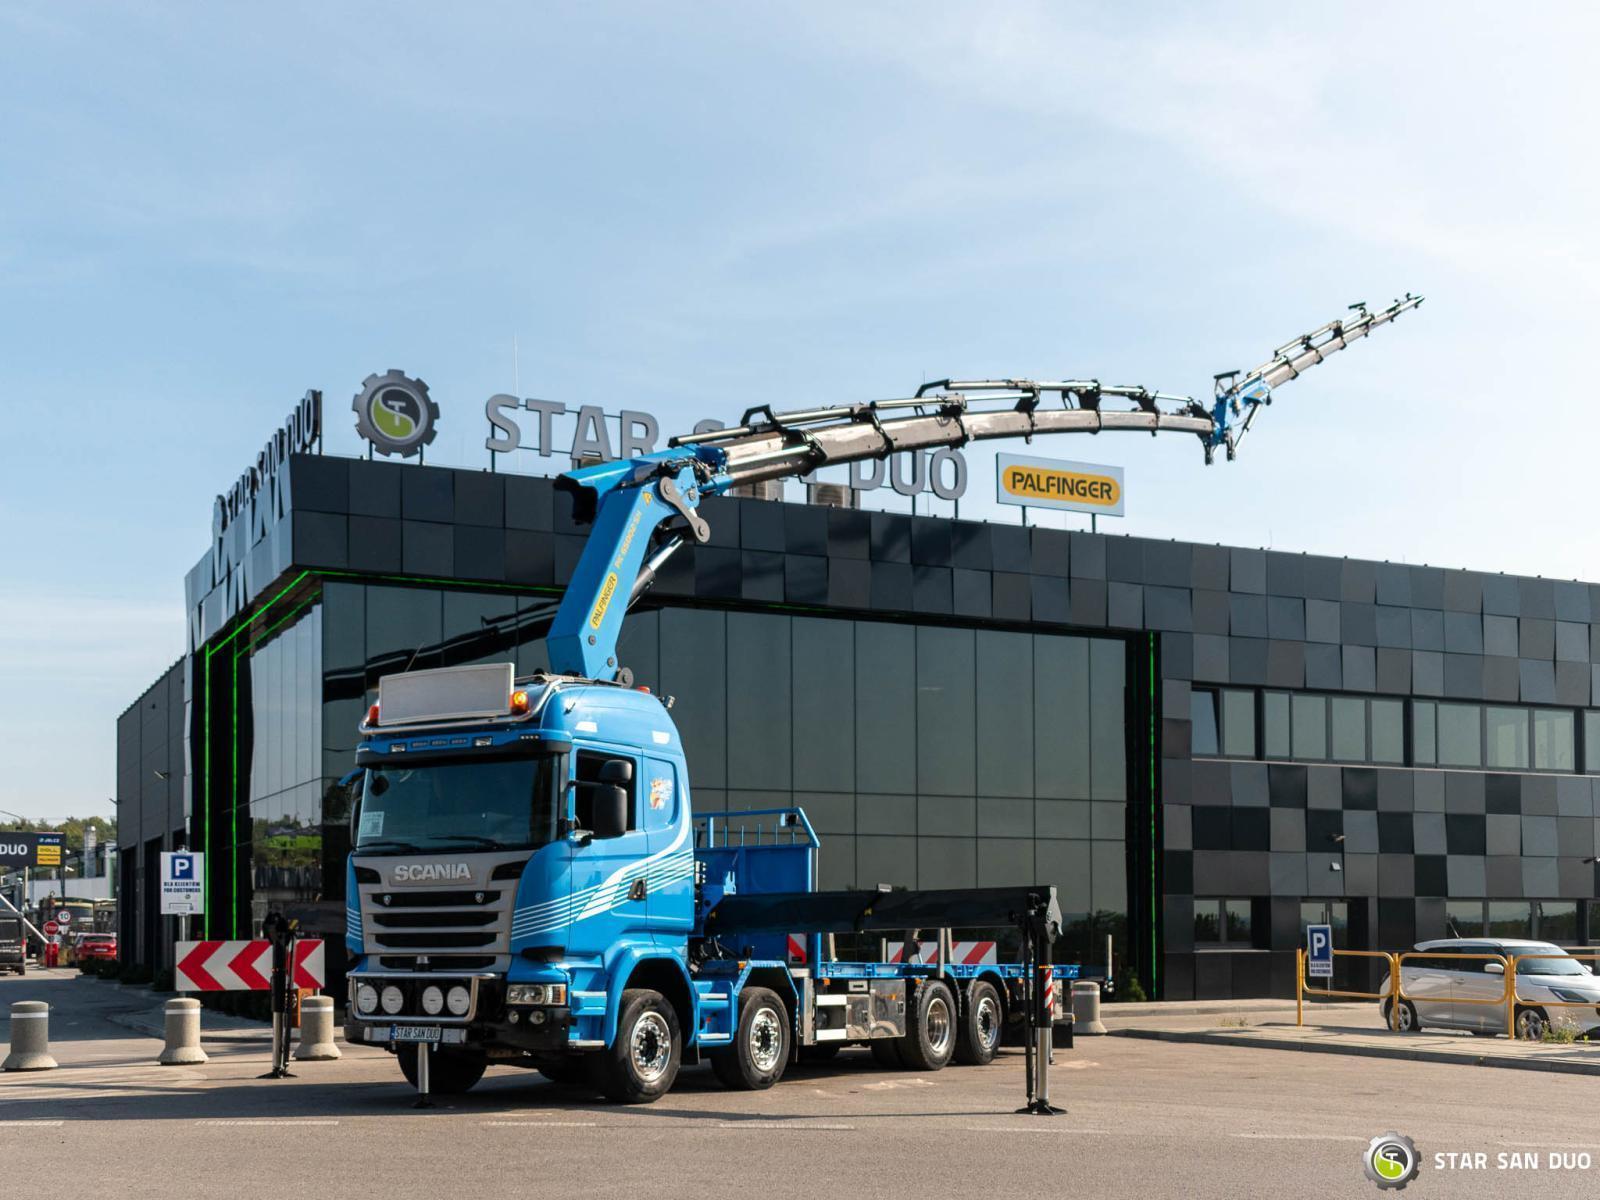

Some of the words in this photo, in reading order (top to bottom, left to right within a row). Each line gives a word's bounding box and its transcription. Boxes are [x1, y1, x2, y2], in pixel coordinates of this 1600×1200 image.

[285, 389, 318, 457] DUO
[486, 393, 659, 462] STAR
[850, 447, 968, 500] DUO
[1011, 471, 1113, 500] PALFINGER
[591, 575, 617, 627] PALFINGER
[0, 843, 28, 856] DUO
[175, 858, 189, 876] P
[394, 863, 472, 881] SCANIA
[1313, 932, 1326, 956] P
[396, 1027, 413, 1039] STAR
[413, 1027, 426, 1039] SAN
